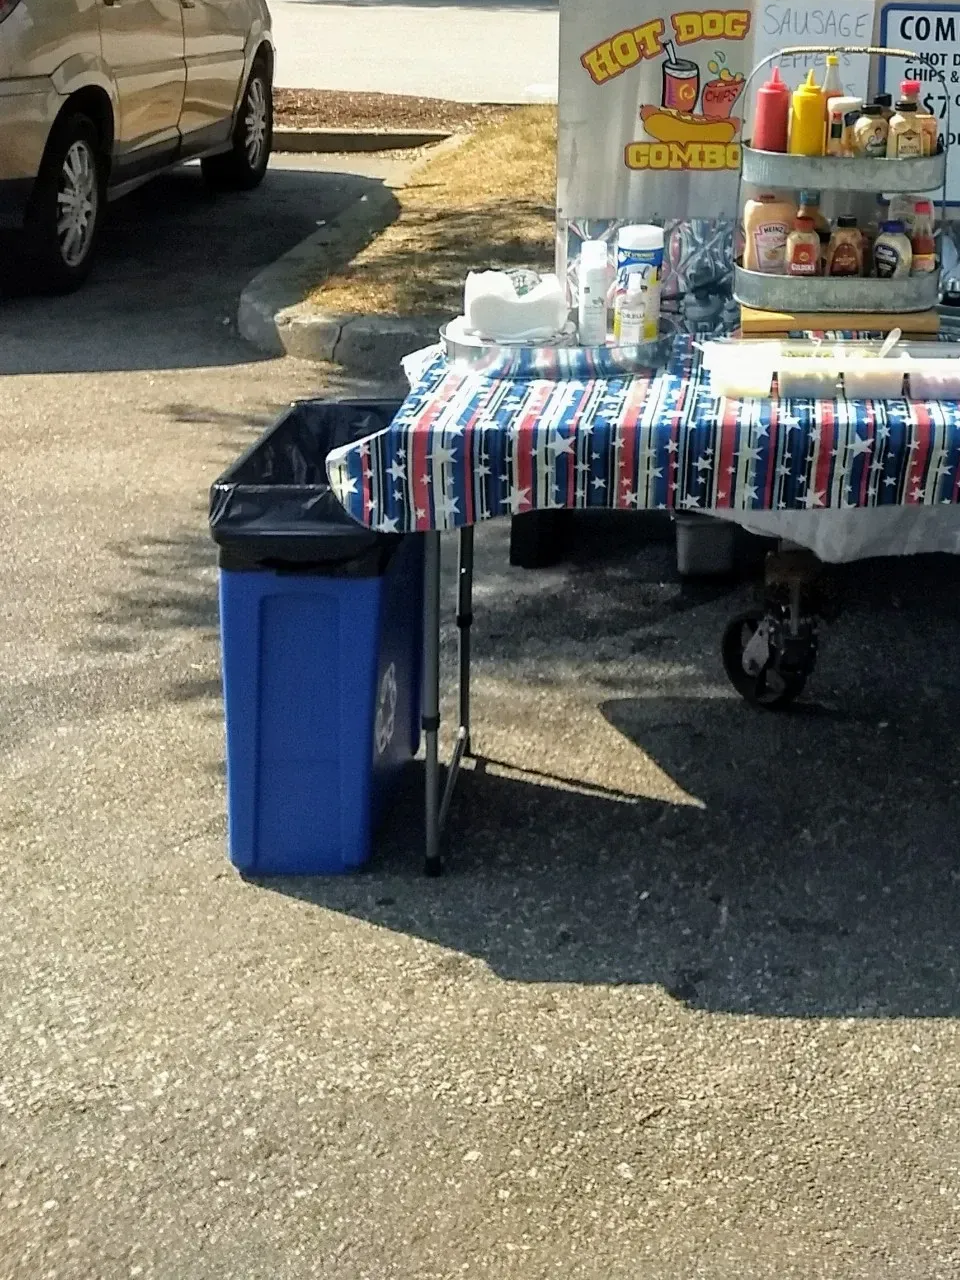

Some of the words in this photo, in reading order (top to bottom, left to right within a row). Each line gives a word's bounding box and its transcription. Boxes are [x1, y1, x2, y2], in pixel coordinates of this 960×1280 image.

[763, 4, 869, 38] SAUSAGE
[582, 20, 664, 84] HOT
[672, 11, 751, 46] DOG
[919, 52, 948, 66] HOT
[904, 68, 946, 83] CHIPS
[950, 70, 959, 83] &
[705, 88, 739, 103] CHIPS
[626, 142, 742, 169] COMBO
